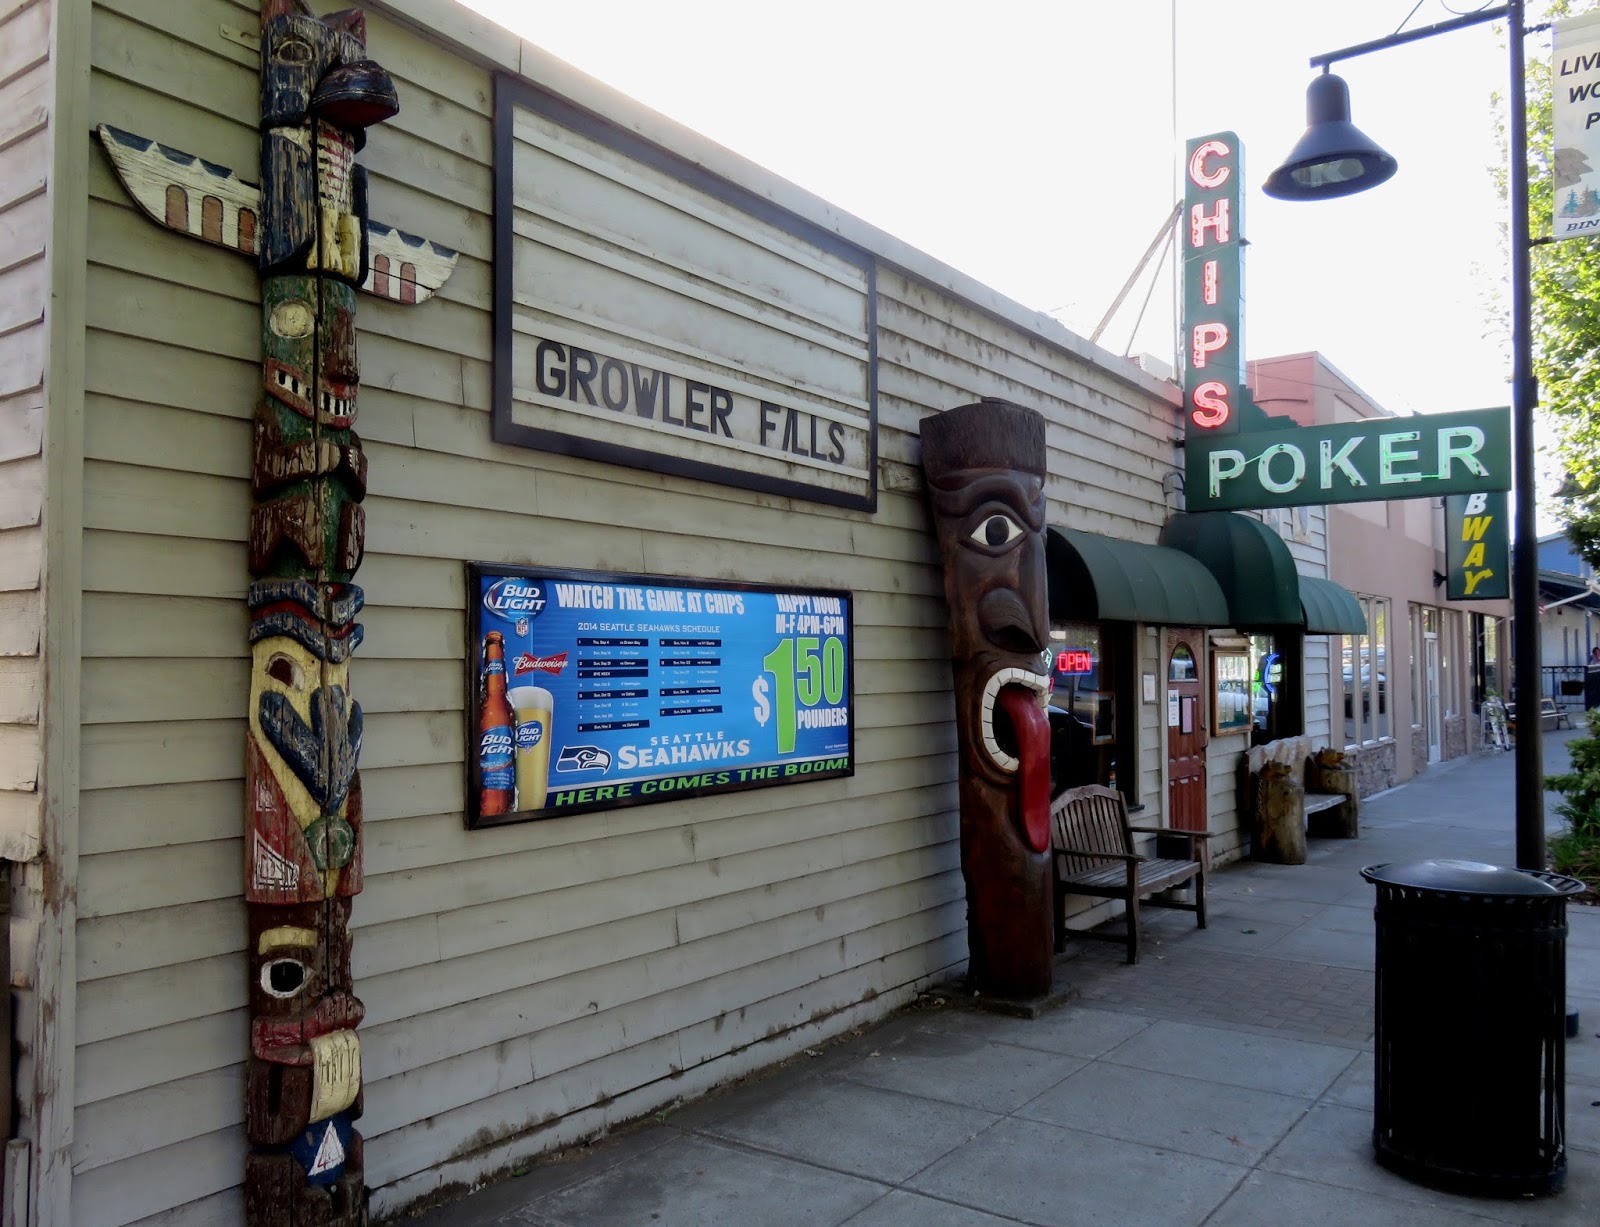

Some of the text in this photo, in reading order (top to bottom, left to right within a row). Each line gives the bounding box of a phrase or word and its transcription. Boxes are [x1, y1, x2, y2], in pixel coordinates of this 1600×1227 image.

[1569, 81, 1600, 103] WO
[1566, 219, 1600, 231] BIN
[1189, 140, 1230, 428] CHIPS
[535, 338, 845, 465] GROWLER FALLS
[1208, 425, 1490, 499] POKER
[1461, 492, 1494, 595] BWAY
[503, 584, 540, 597] BUD
[555, 584, 745, 615] WATCH THE GAME AT CHIPS
[494, 597, 546, 610] LIGHT
[775, 593, 841, 615] HAPPY HOUR
[578, 622, 720, 633] 2014 SEATTLE SEAHAWKS SCHEDULE
[775, 614, 844, 635] M-F 4PM-6PM
[512, 656, 568, 670] Budweiser
[1058, 652, 1091, 671] OPEN
[797, 707, 848, 730] POUNDERS
[480, 734, 512, 746] BUD
[519, 727, 540, 736] BUD
[650, 731, 724, 746] SEATTLE
[617, 739, 750, 771] SEAHAWKS
[555, 757, 848, 807] HERE COMES THE BOOM!
